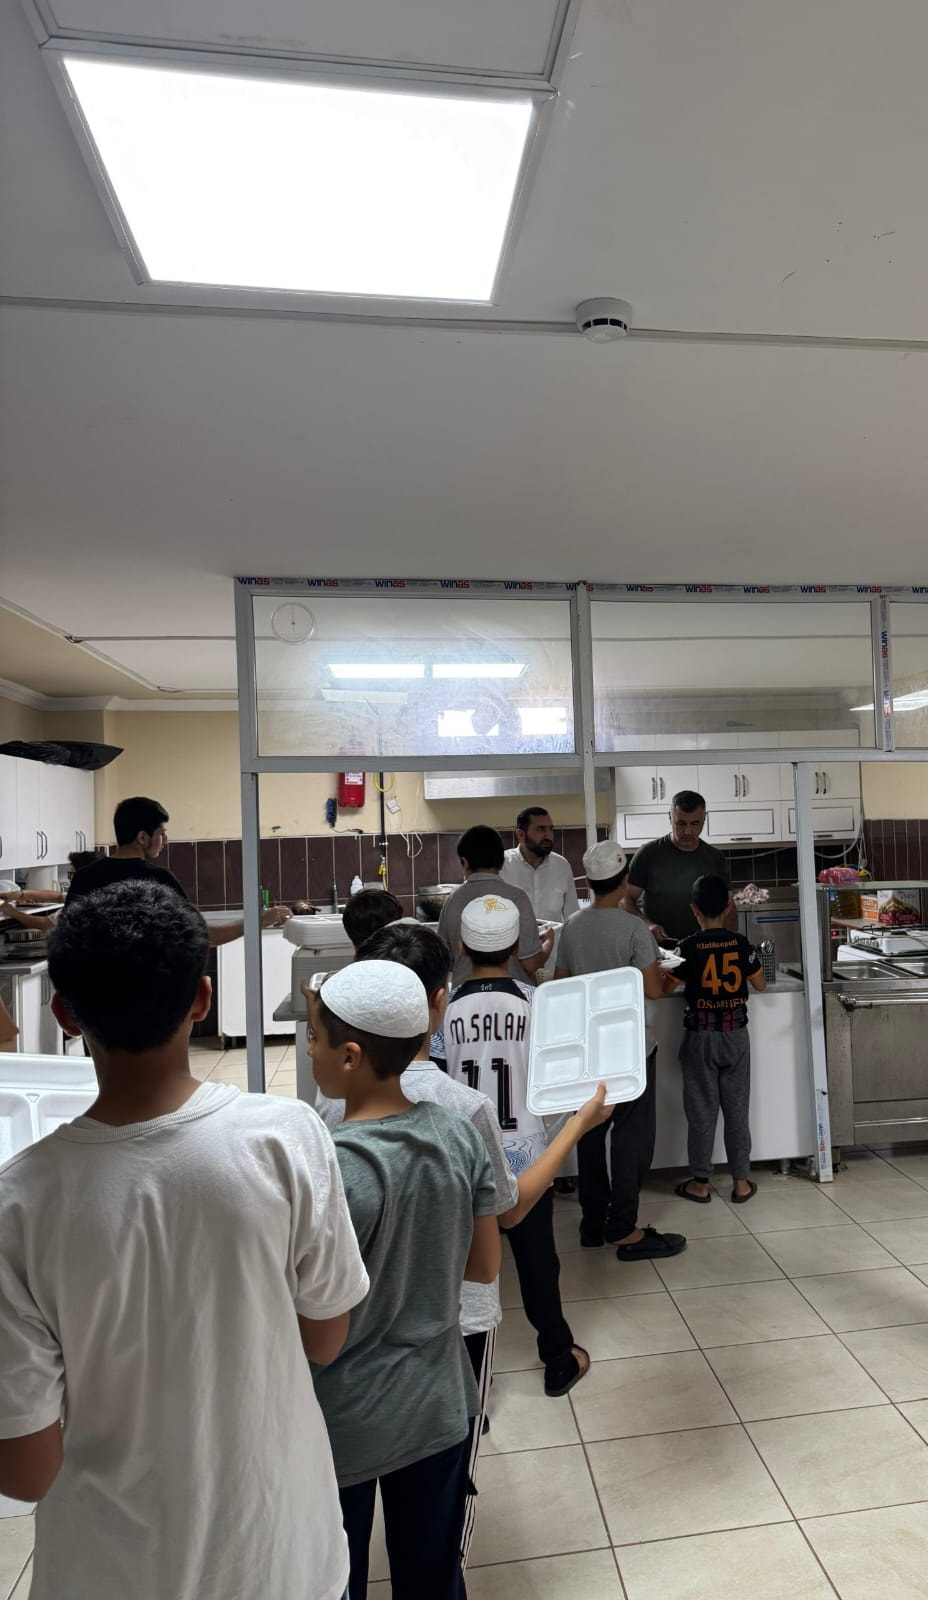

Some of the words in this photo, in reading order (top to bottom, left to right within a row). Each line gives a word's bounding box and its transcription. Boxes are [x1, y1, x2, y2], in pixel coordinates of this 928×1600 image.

[238, 576, 270, 585] winas
[307, 577, 339, 587] winas
[375, 578, 405, 588] winas
[440, 579, 470, 589] winas
[504, 580, 533, 590] winas
[566, 582, 594, 592] wis
[626, 583, 654, 593] winas
[685, 584, 713, 593] winas
[743, 585, 770, 594] winas
[800, 585, 827, 593] winas
[856, 585, 883, 593] winas
[881, 631, 889, 659] winas
[701, 951, 742, 995] 45
[450, 1012, 526, 1045] M.SALAH
